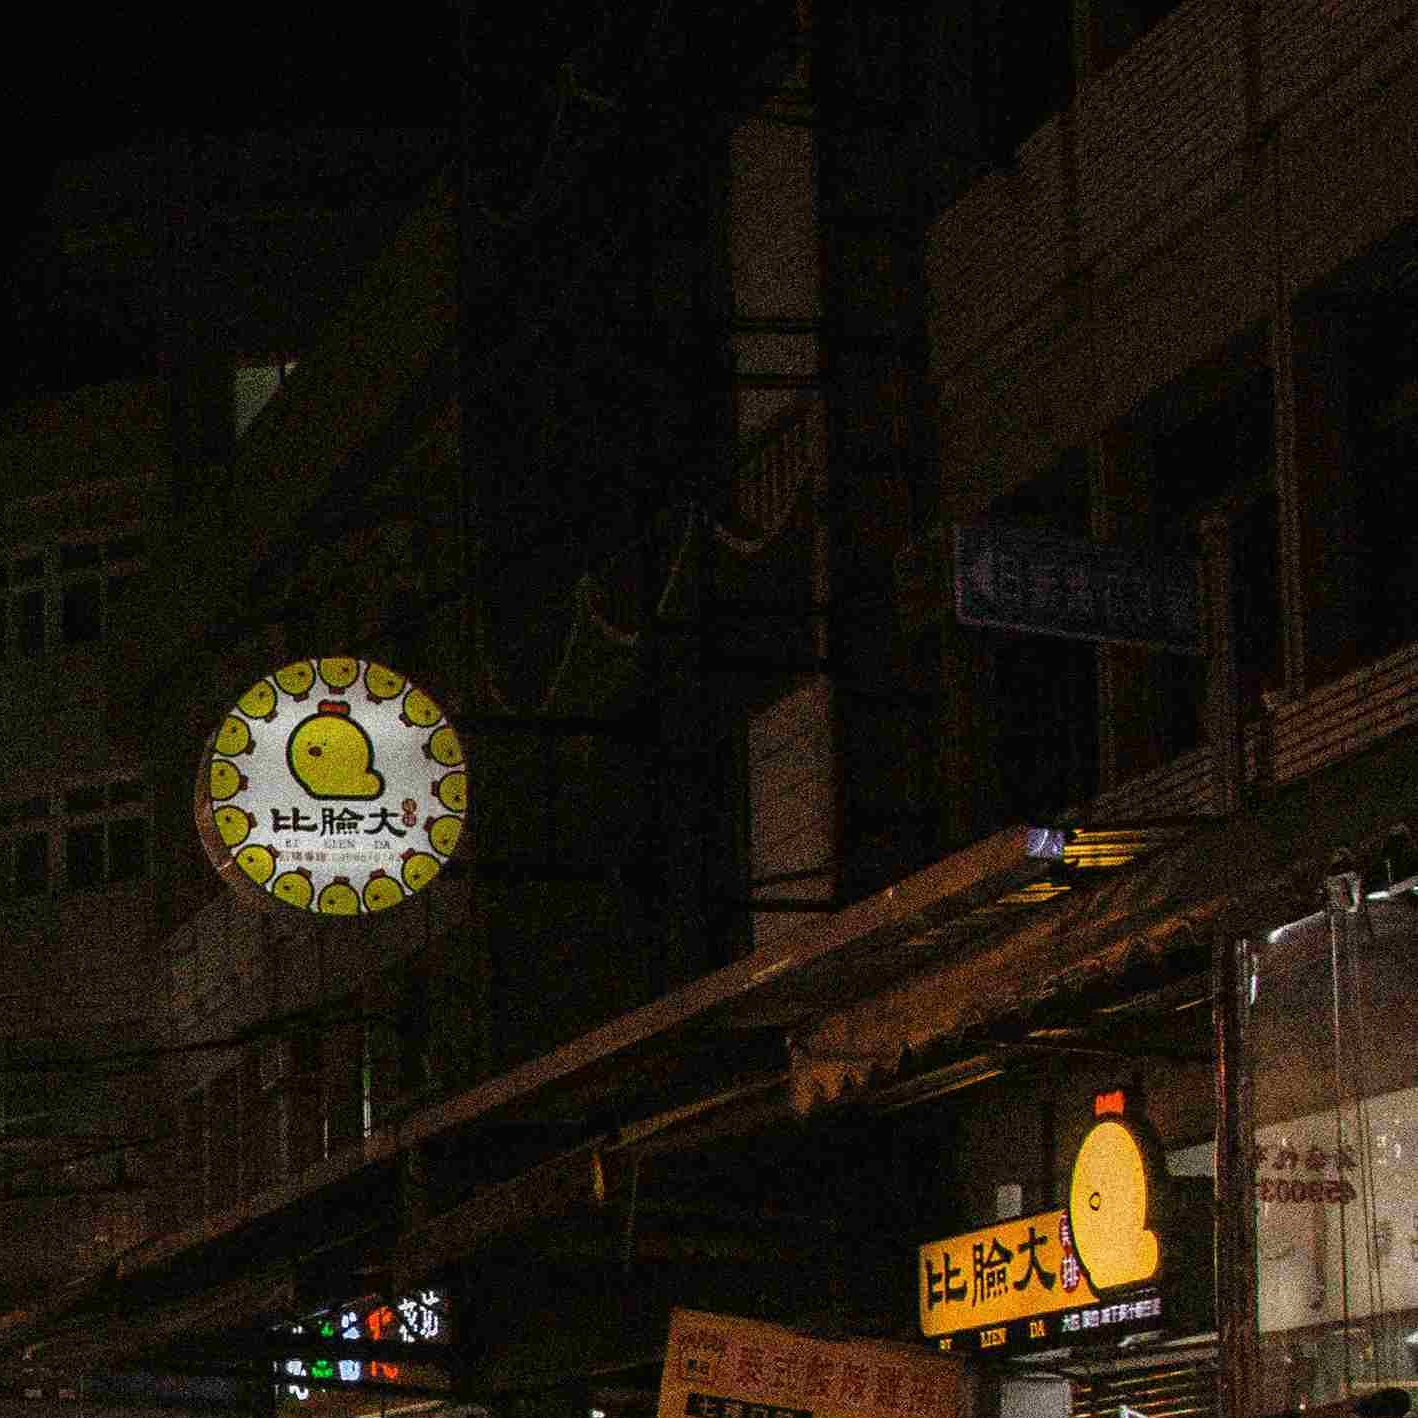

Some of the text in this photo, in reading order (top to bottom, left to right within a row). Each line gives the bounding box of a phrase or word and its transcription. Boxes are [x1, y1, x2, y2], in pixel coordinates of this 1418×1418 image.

[271, 807, 406, 837] 比臉大
[926, 1227, 1056, 1311] 比臉大
